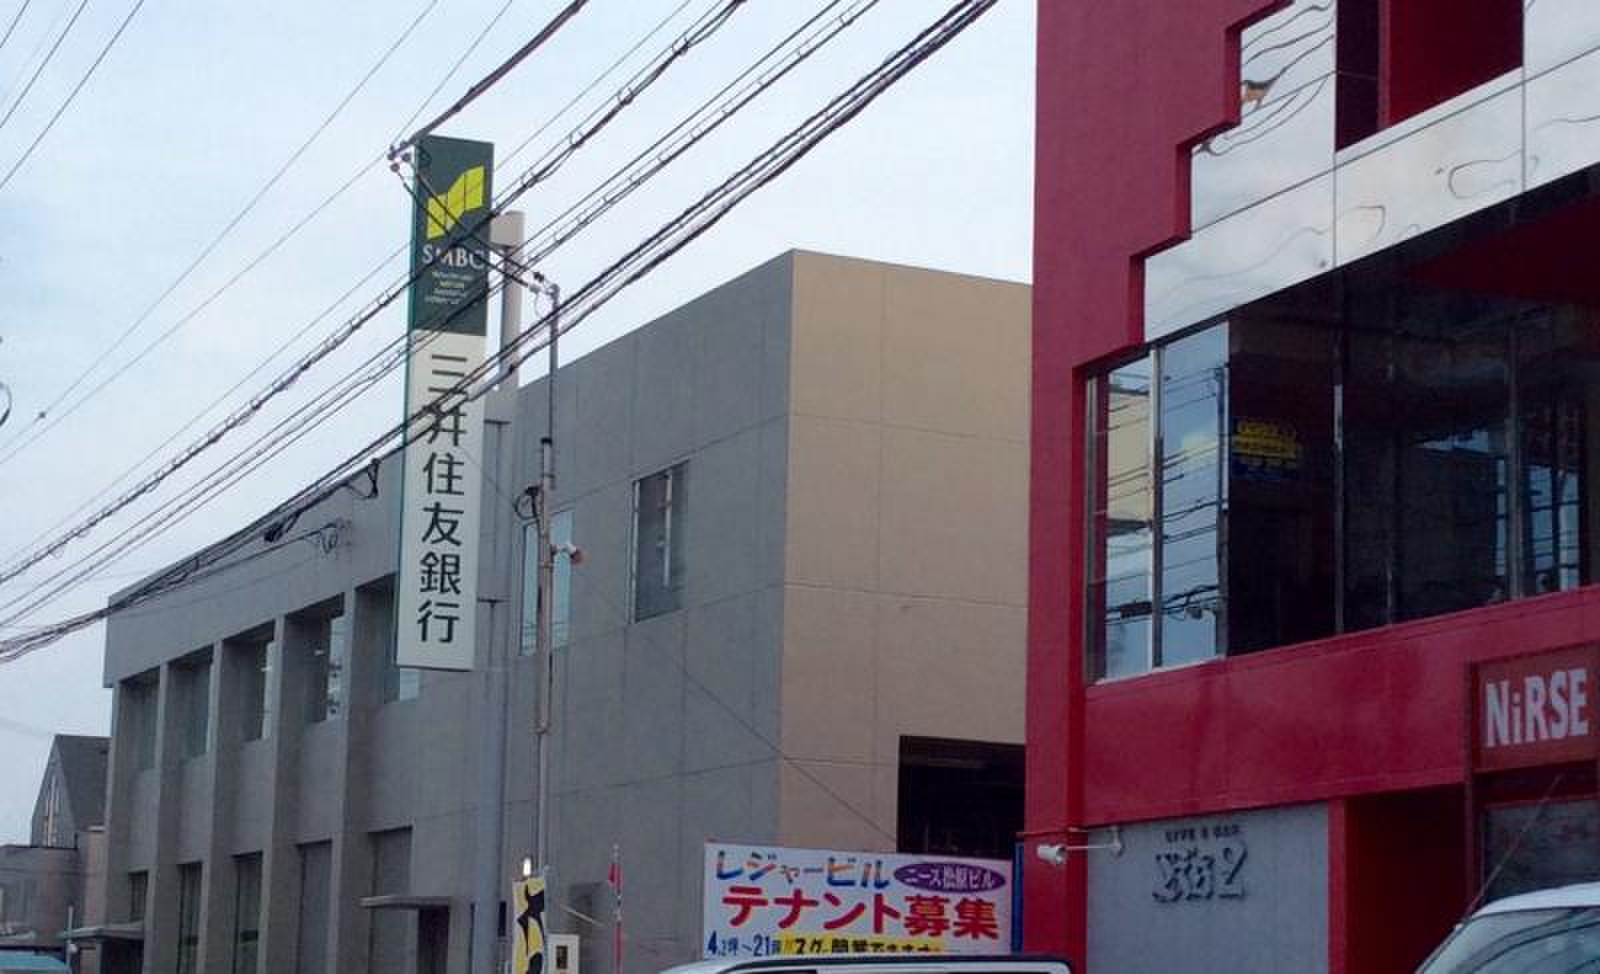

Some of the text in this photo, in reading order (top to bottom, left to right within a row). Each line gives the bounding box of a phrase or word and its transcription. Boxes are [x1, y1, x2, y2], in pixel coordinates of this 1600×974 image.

[421, 243, 485, 270] SMBC
[415, 353, 468, 644] 三井住友銀行
[1485, 668, 1590, 748] NiRSE
[715, 850, 891, 890] レジャービル
[721, 885, 999, 940] テナント募集
